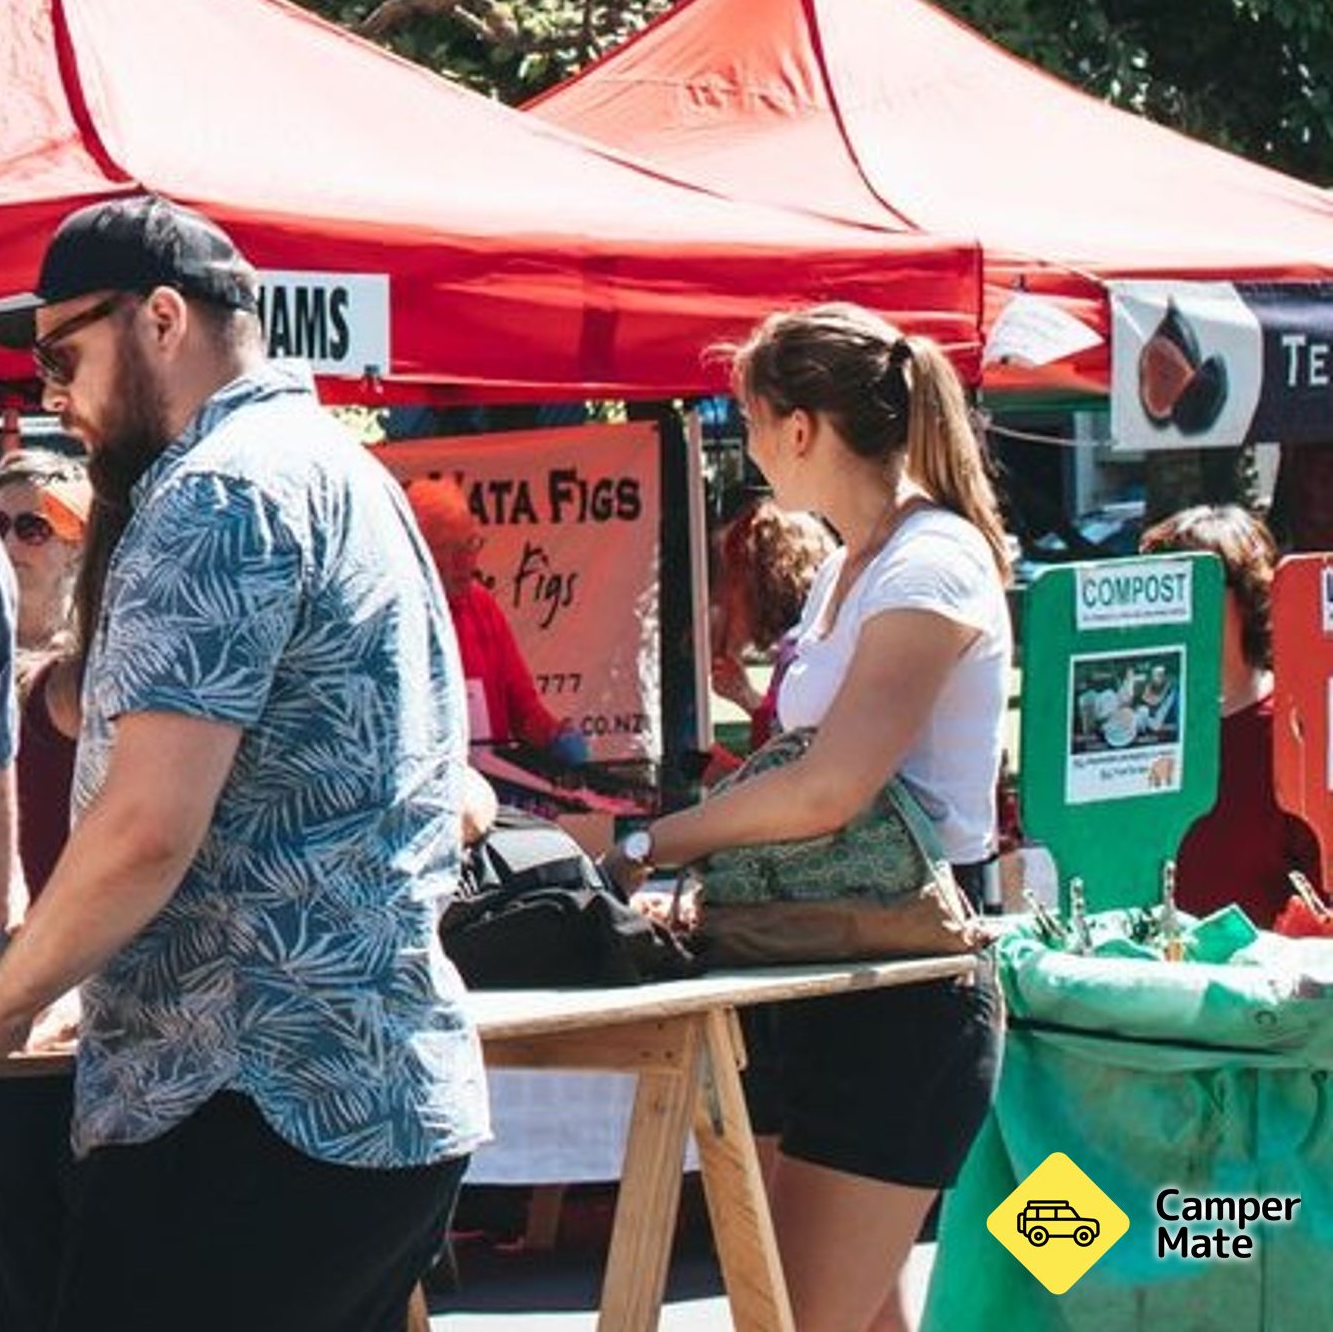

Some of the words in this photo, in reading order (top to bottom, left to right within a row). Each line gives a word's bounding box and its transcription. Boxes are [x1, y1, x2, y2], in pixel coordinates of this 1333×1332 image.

[550, 466, 641, 525] FIGS
[514, 541, 581, 629] Figs
[1082, 573, 1186, 607] COMPOST
